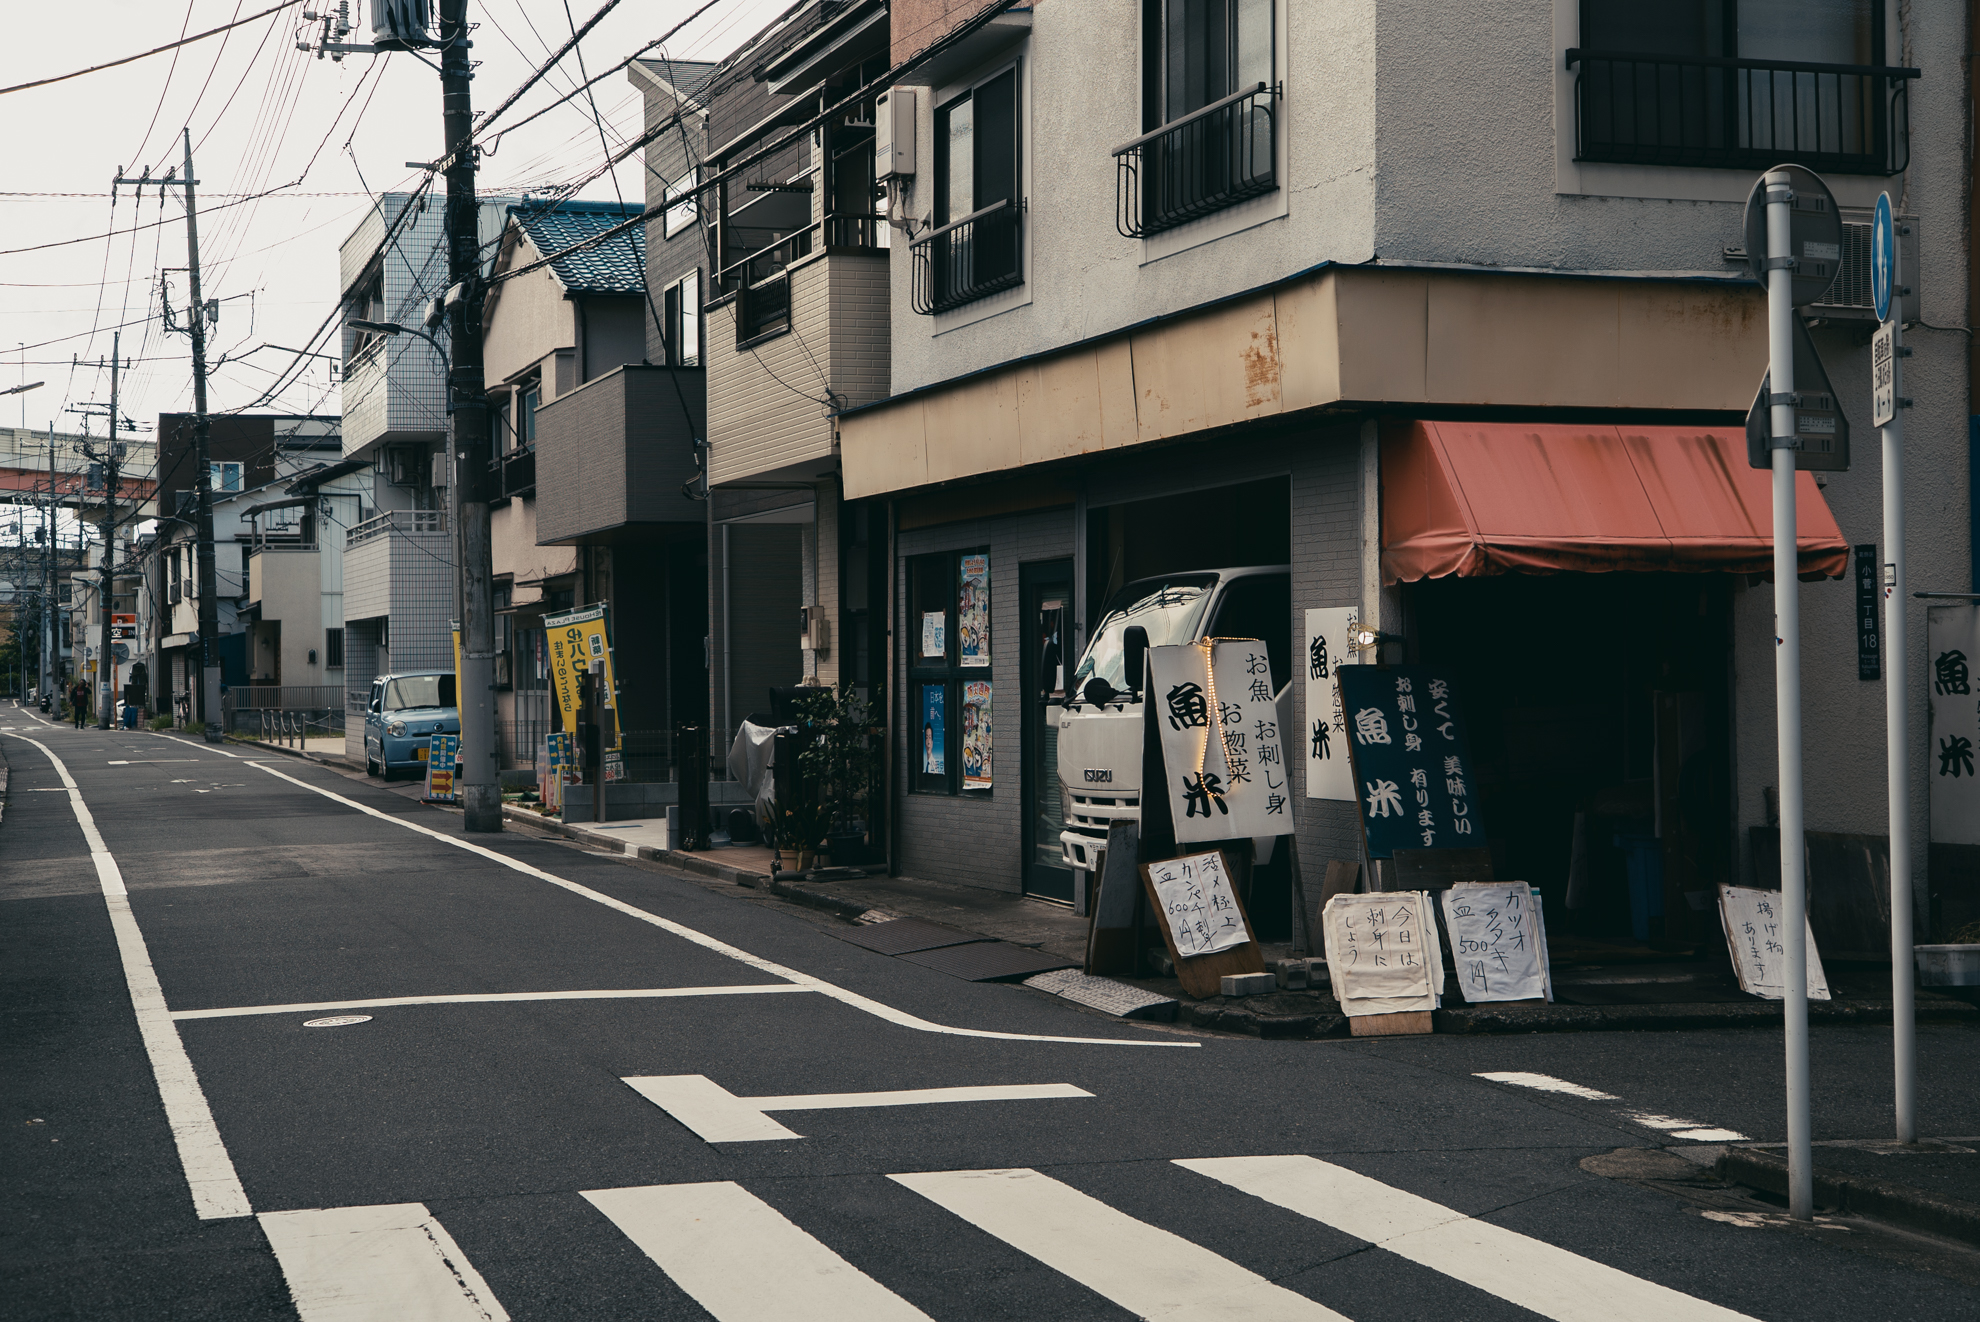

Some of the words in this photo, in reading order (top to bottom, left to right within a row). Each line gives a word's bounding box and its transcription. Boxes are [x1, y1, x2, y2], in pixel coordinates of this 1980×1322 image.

[1862, 565, 1873, 629] 小菅一丁目
[1862, 633, 1877, 648] 18
[930, 691, 944, 704] 日本を
[1245, 653, 1273, 702] お魚
[1084, 768, 1112, 782] ISUZU
[1255, 720, 1286, 815] お刺し身
[1395, 676, 1422, 752] お刺し身
[1410, 768, 1436, 847] 有ります
[1428, 678, 1454, 740] 安くて
[1444, 755, 1471, 834] 美味しい
[1367, 908, 1387, 966] 刺身に
[1391, 906, 1419, 966] 今日は
[1450, 897, 1475, 919] 一皿
[1506, 891, 1525, 951] カツオ
[1757, 901, 1783, 955] 揚げ物
[1345, 916, 1358, 967] しょう
[1486, 908, 1509, 975] タタキ
[1742, 921, 1765, 981] あります
